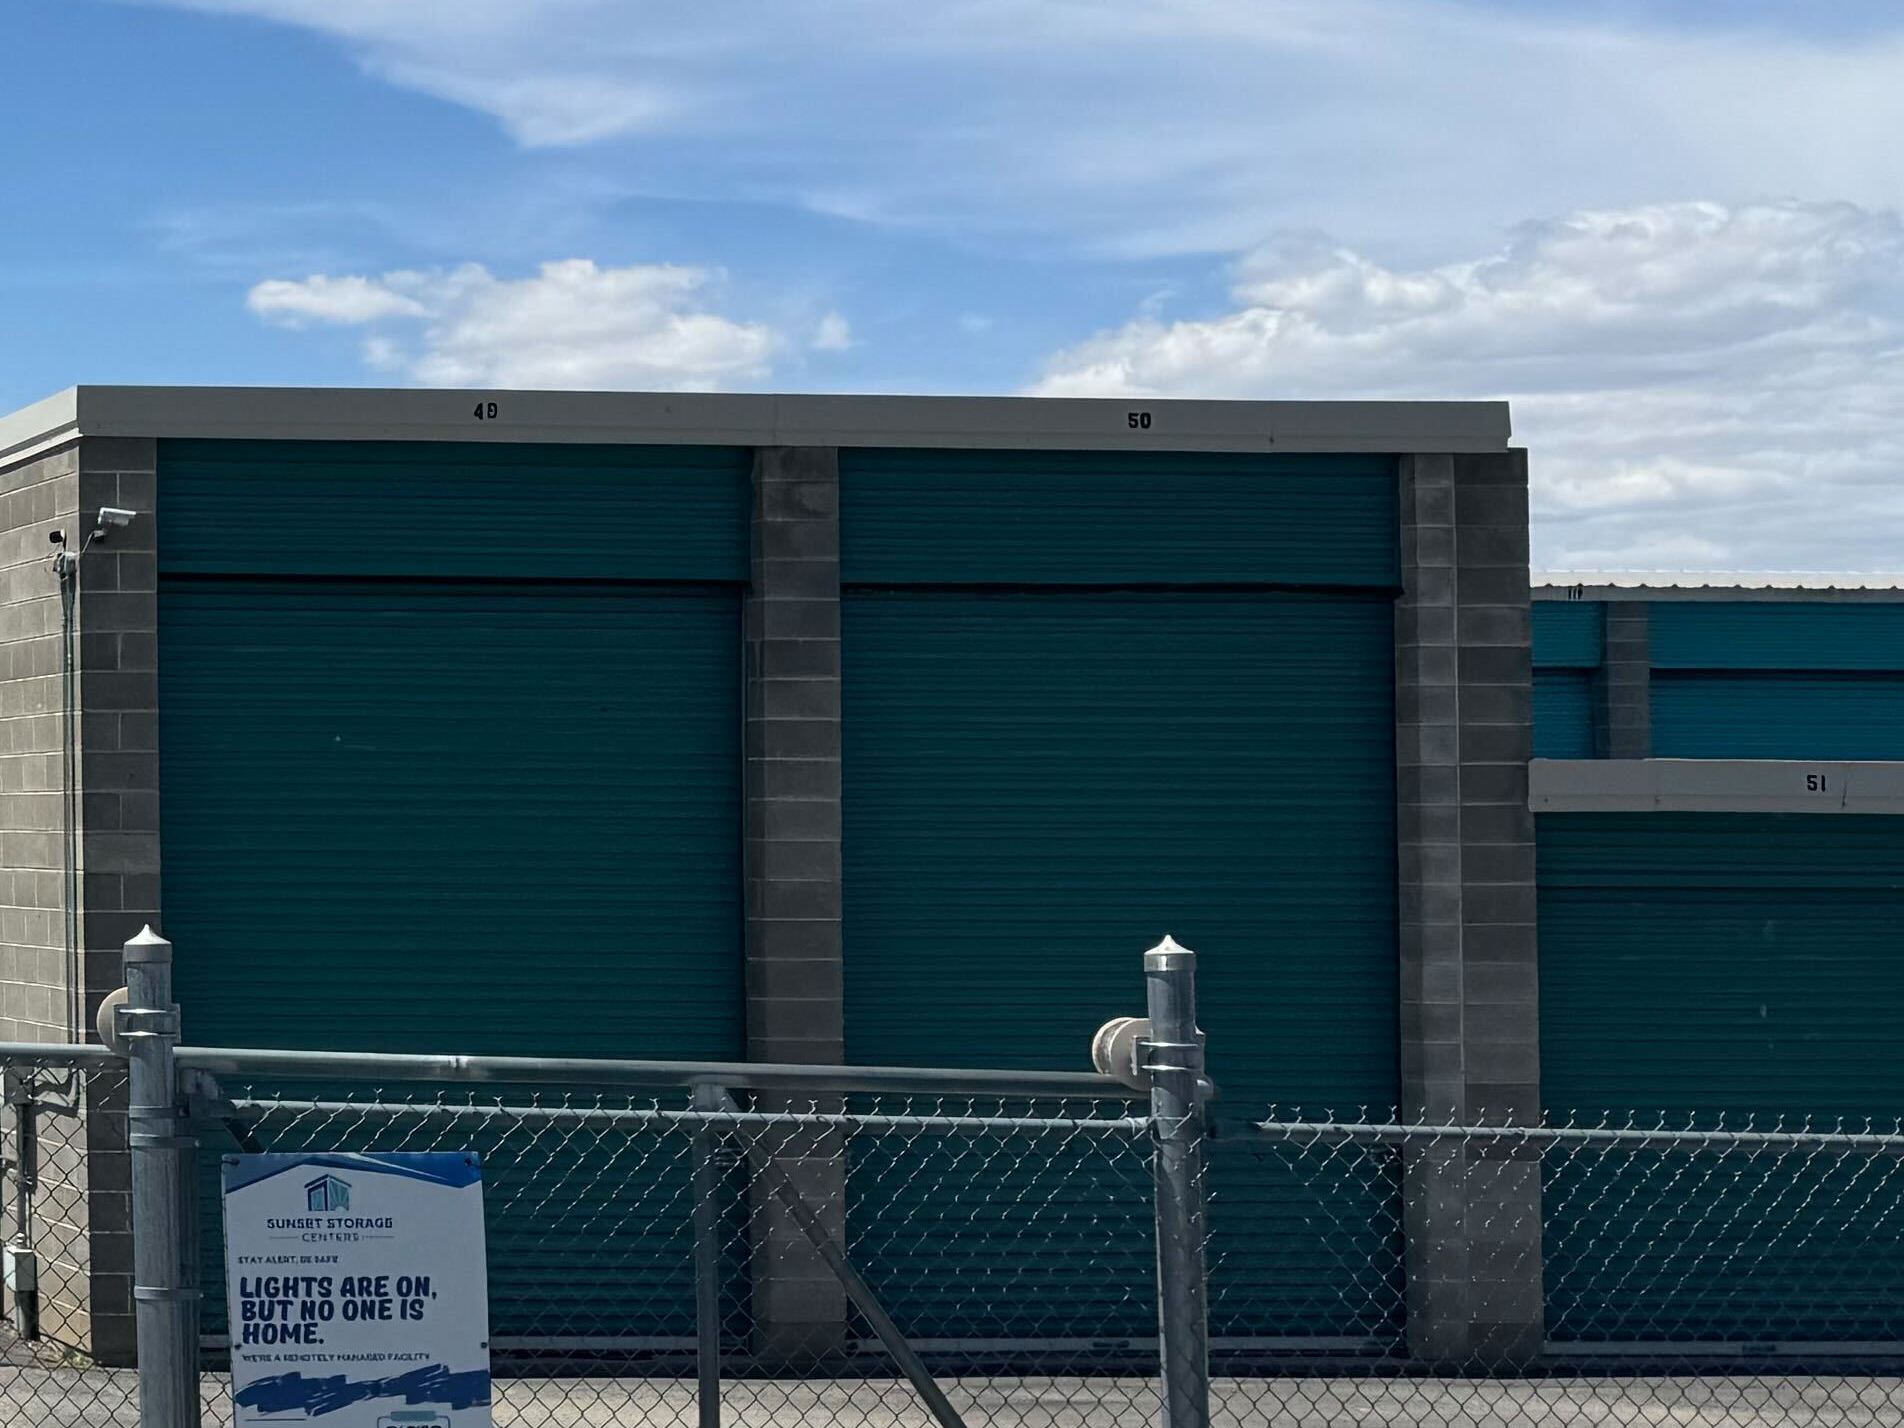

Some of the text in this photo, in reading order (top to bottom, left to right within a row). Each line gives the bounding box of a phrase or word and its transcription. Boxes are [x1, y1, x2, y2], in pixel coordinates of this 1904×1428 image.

[473, 402, 498, 420] 49
[1127, 411, 1152, 429] 50
[1807, 774, 1826, 792] 51
[266, 1218, 392, 1229] SUNSET STORAGE
[301, 1232, 360, 1242] CENTERS
[237, 1256, 263, 1264] STAY
[239, 1275, 437, 1300] LIGHTS ARE ON,
[241, 1299, 425, 1322] BUT NO ONE IS
[242, 1322, 324, 1345] HOME.
[274, 1354, 281, 1362] A
[283, 1353, 335, 1362] REMOTELY
[388, 1353, 430, 1362] FACILITY
